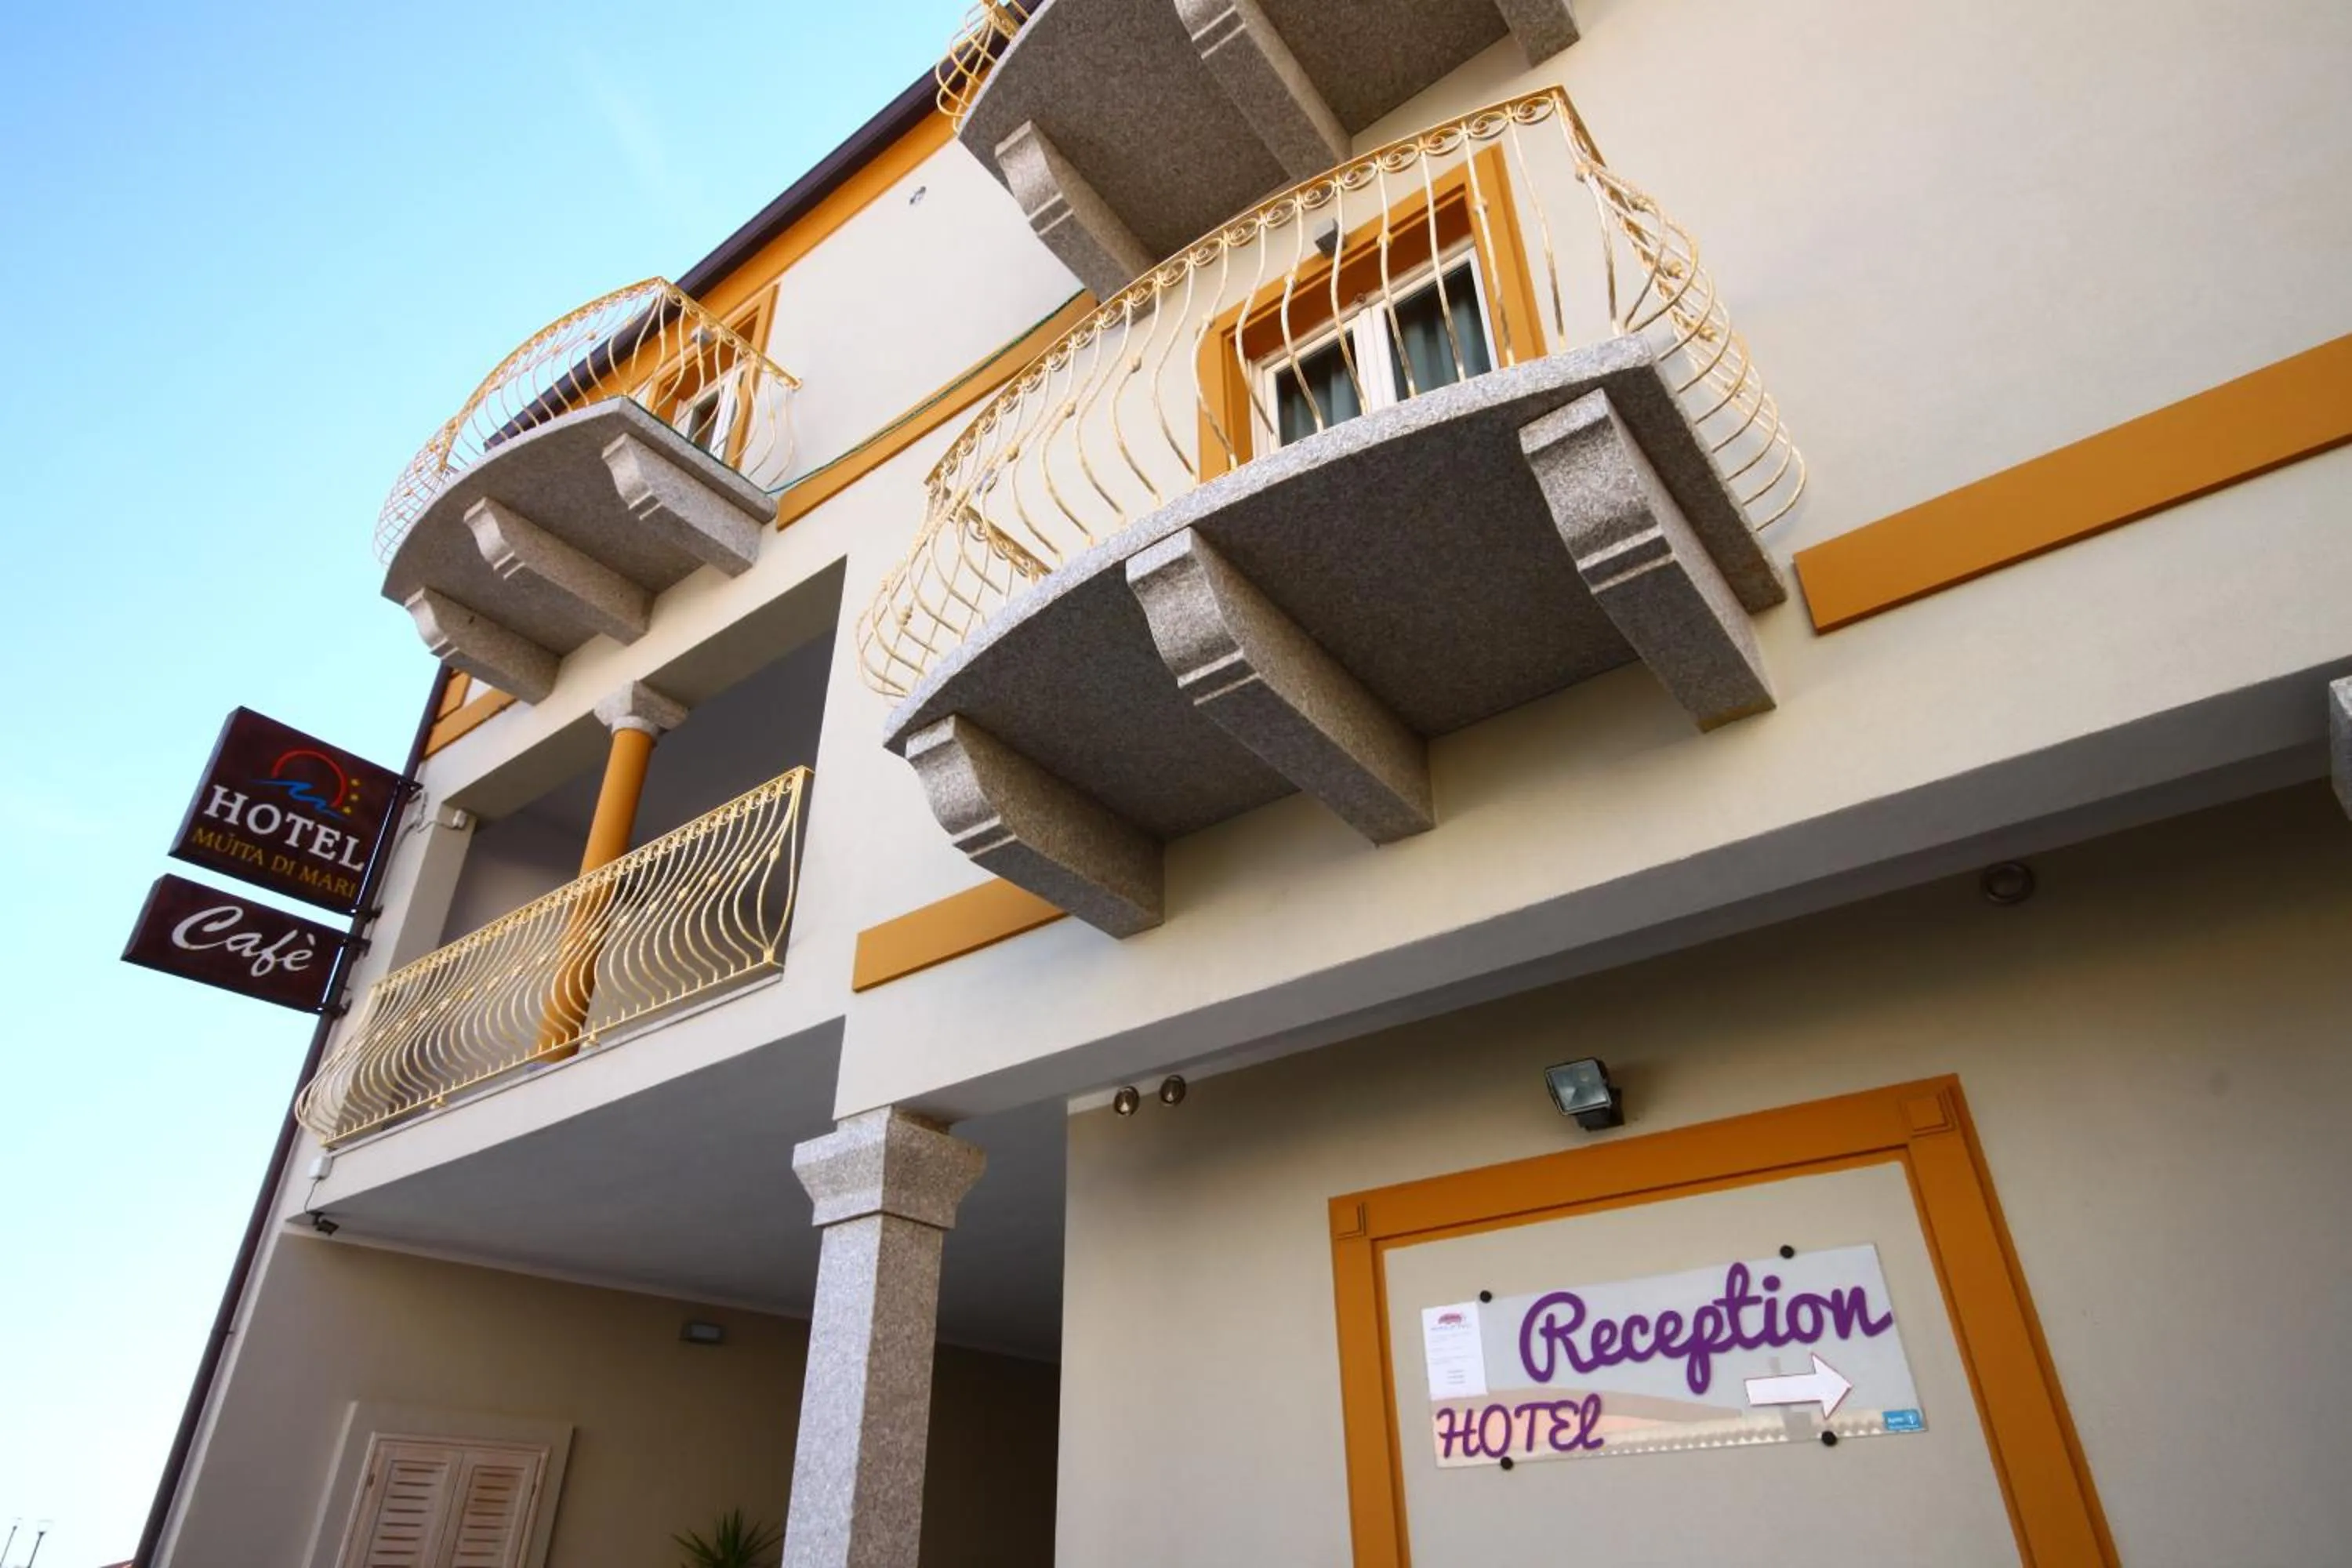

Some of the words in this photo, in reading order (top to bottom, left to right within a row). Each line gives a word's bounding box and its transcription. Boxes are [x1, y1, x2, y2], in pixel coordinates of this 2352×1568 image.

[204, 785, 365, 872] HOTEL
[270, 855, 296, 876] DI
[299, 865, 358, 898] MARI
[1519, 1262, 1893, 1394] Reception
